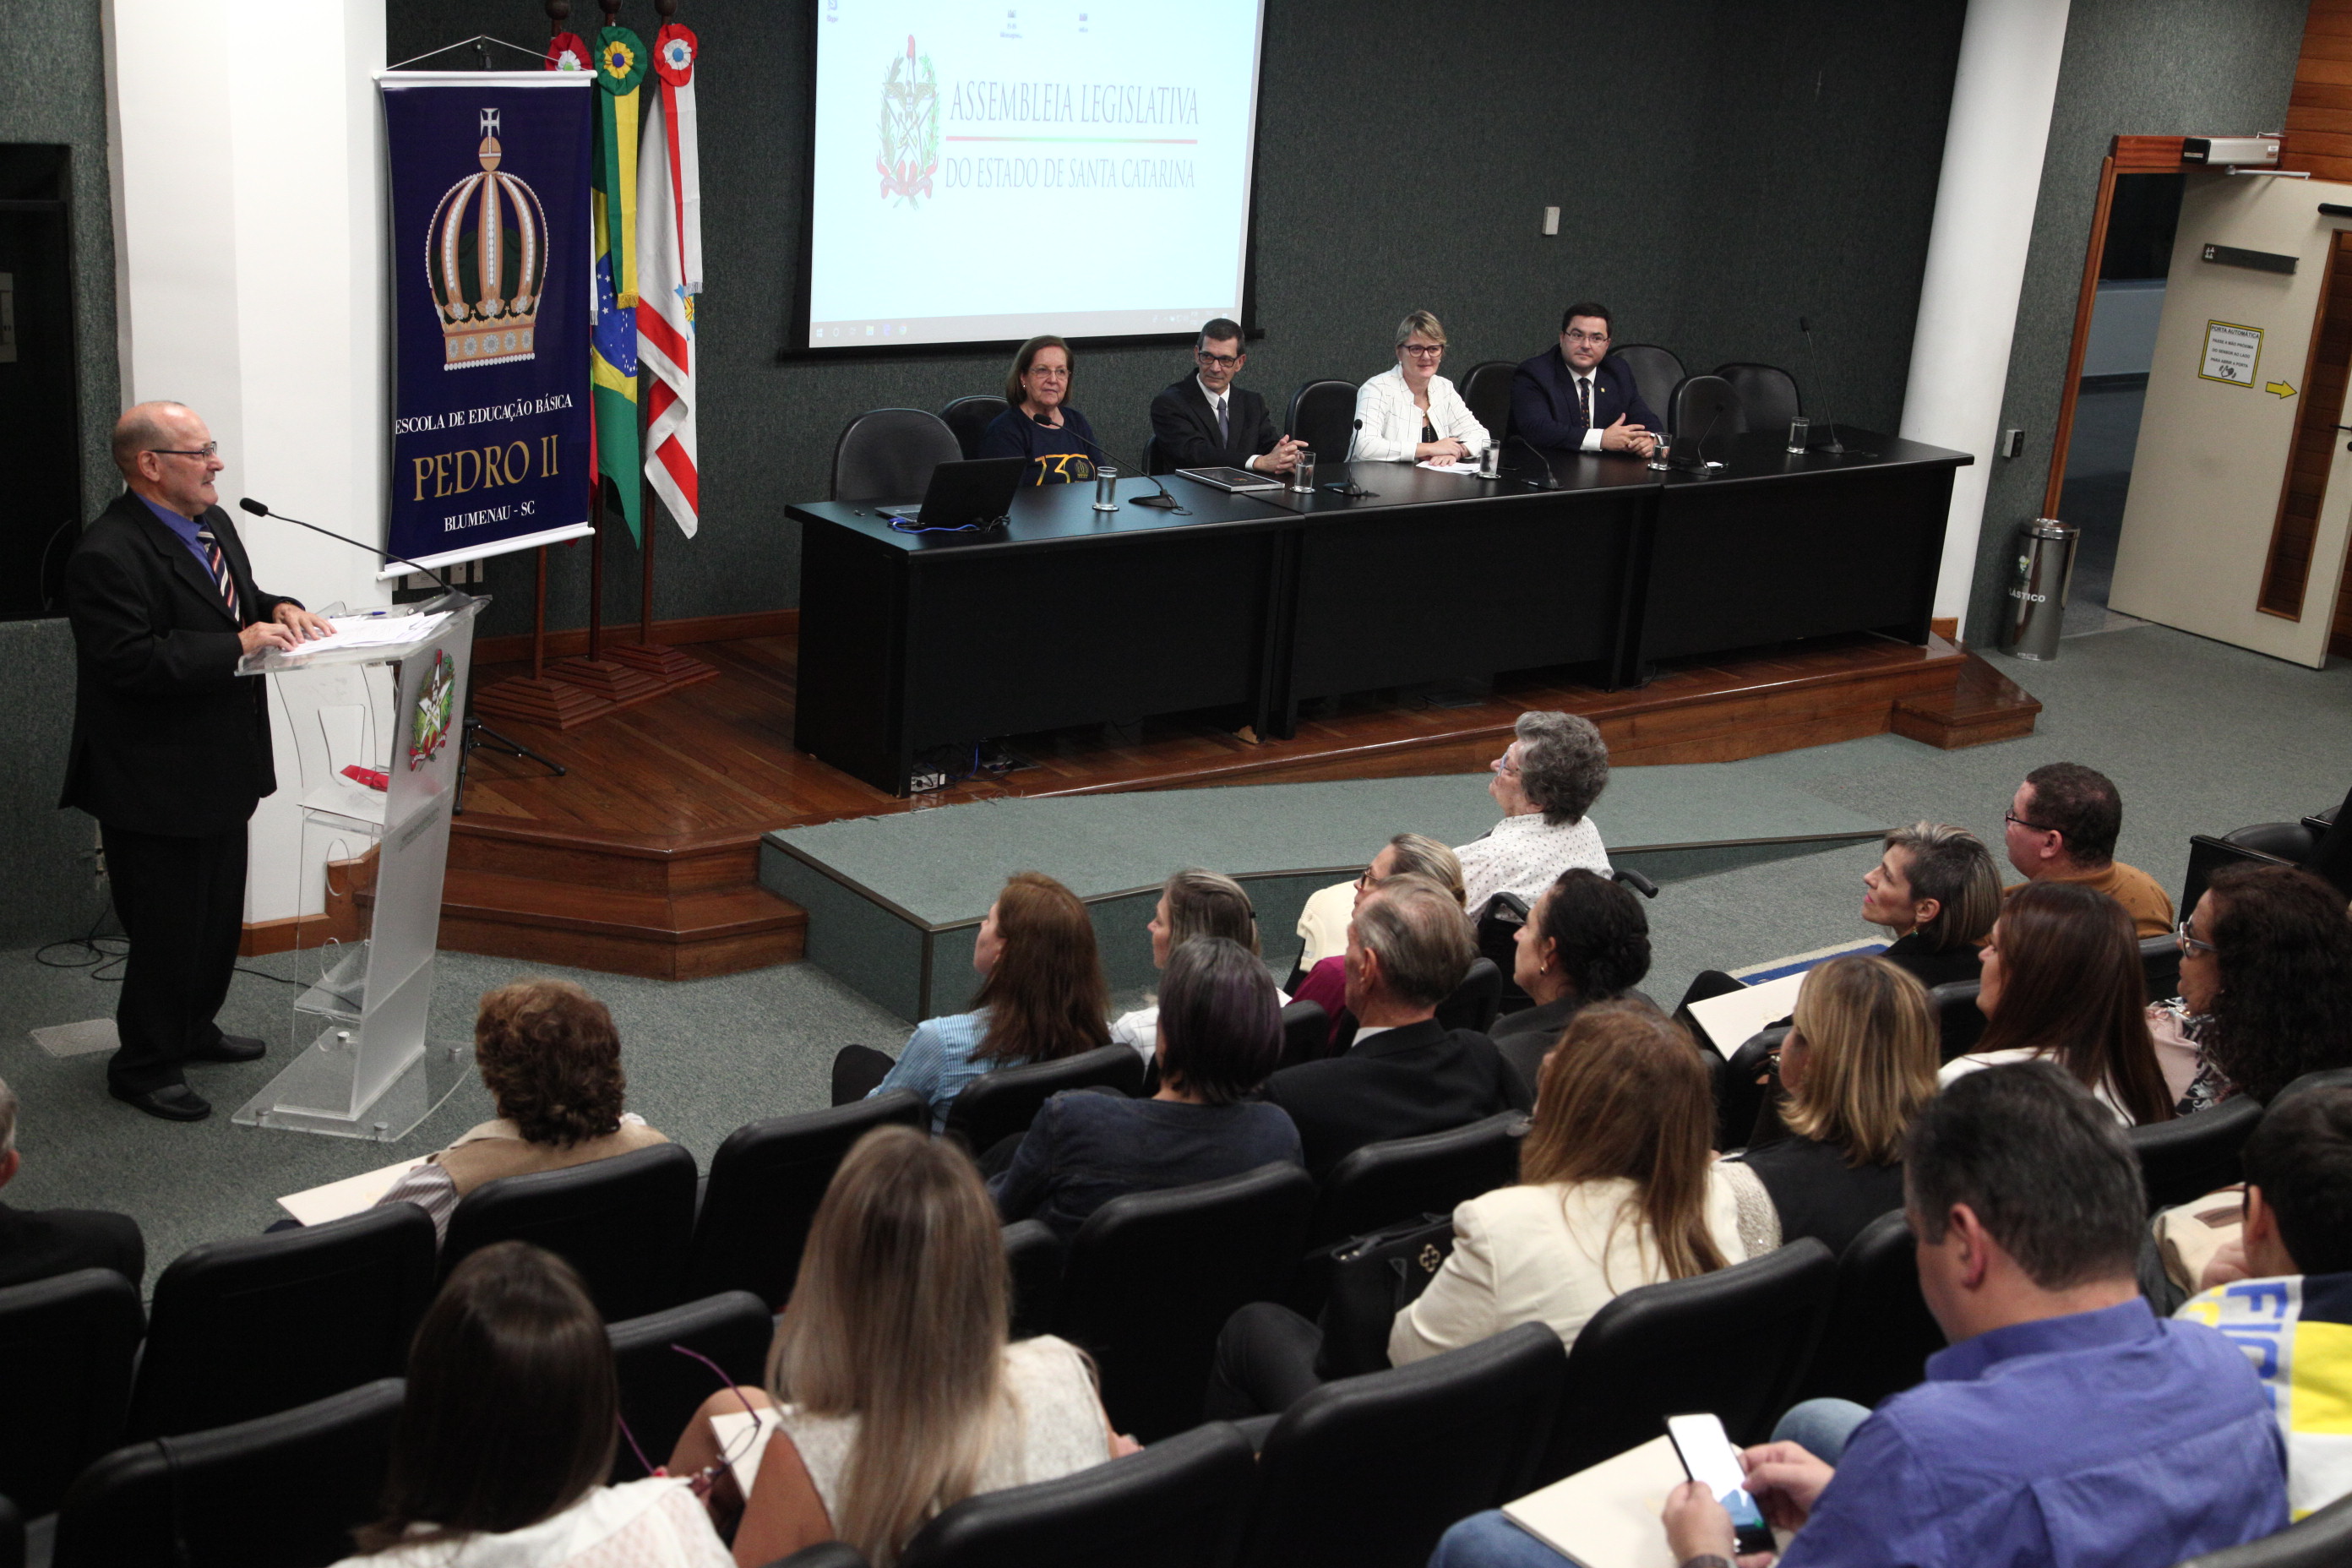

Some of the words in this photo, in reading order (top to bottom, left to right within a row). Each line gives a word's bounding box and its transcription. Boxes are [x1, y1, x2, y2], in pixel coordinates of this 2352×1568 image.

[949, 80, 1074, 122] ASSEMBLEIA
[1081, 84, 1199, 124] LEGISLATIVA
[945, 157, 972, 188] DO
[977, 157, 1038, 188] ESTADO
[1044, 158, 1064, 188] DE
[1068, 158, 1117, 188] SANTA
[1122, 158, 1195, 188] CATARINA
[395, 414, 445, 435] ESCOLA
[449, 411, 466, 427] DE
[468, 399, 533, 424] EDUCAÇÃO
[536, 393, 573, 414] BÁSICA
[412, 440, 531, 501] PEDRO
[540, 434, 559, 478] II
[444, 505, 511, 532] BLUMENAU
[520, 500, 535, 517] SC
[2009, 587, 2045, 602] LÁSTICO
